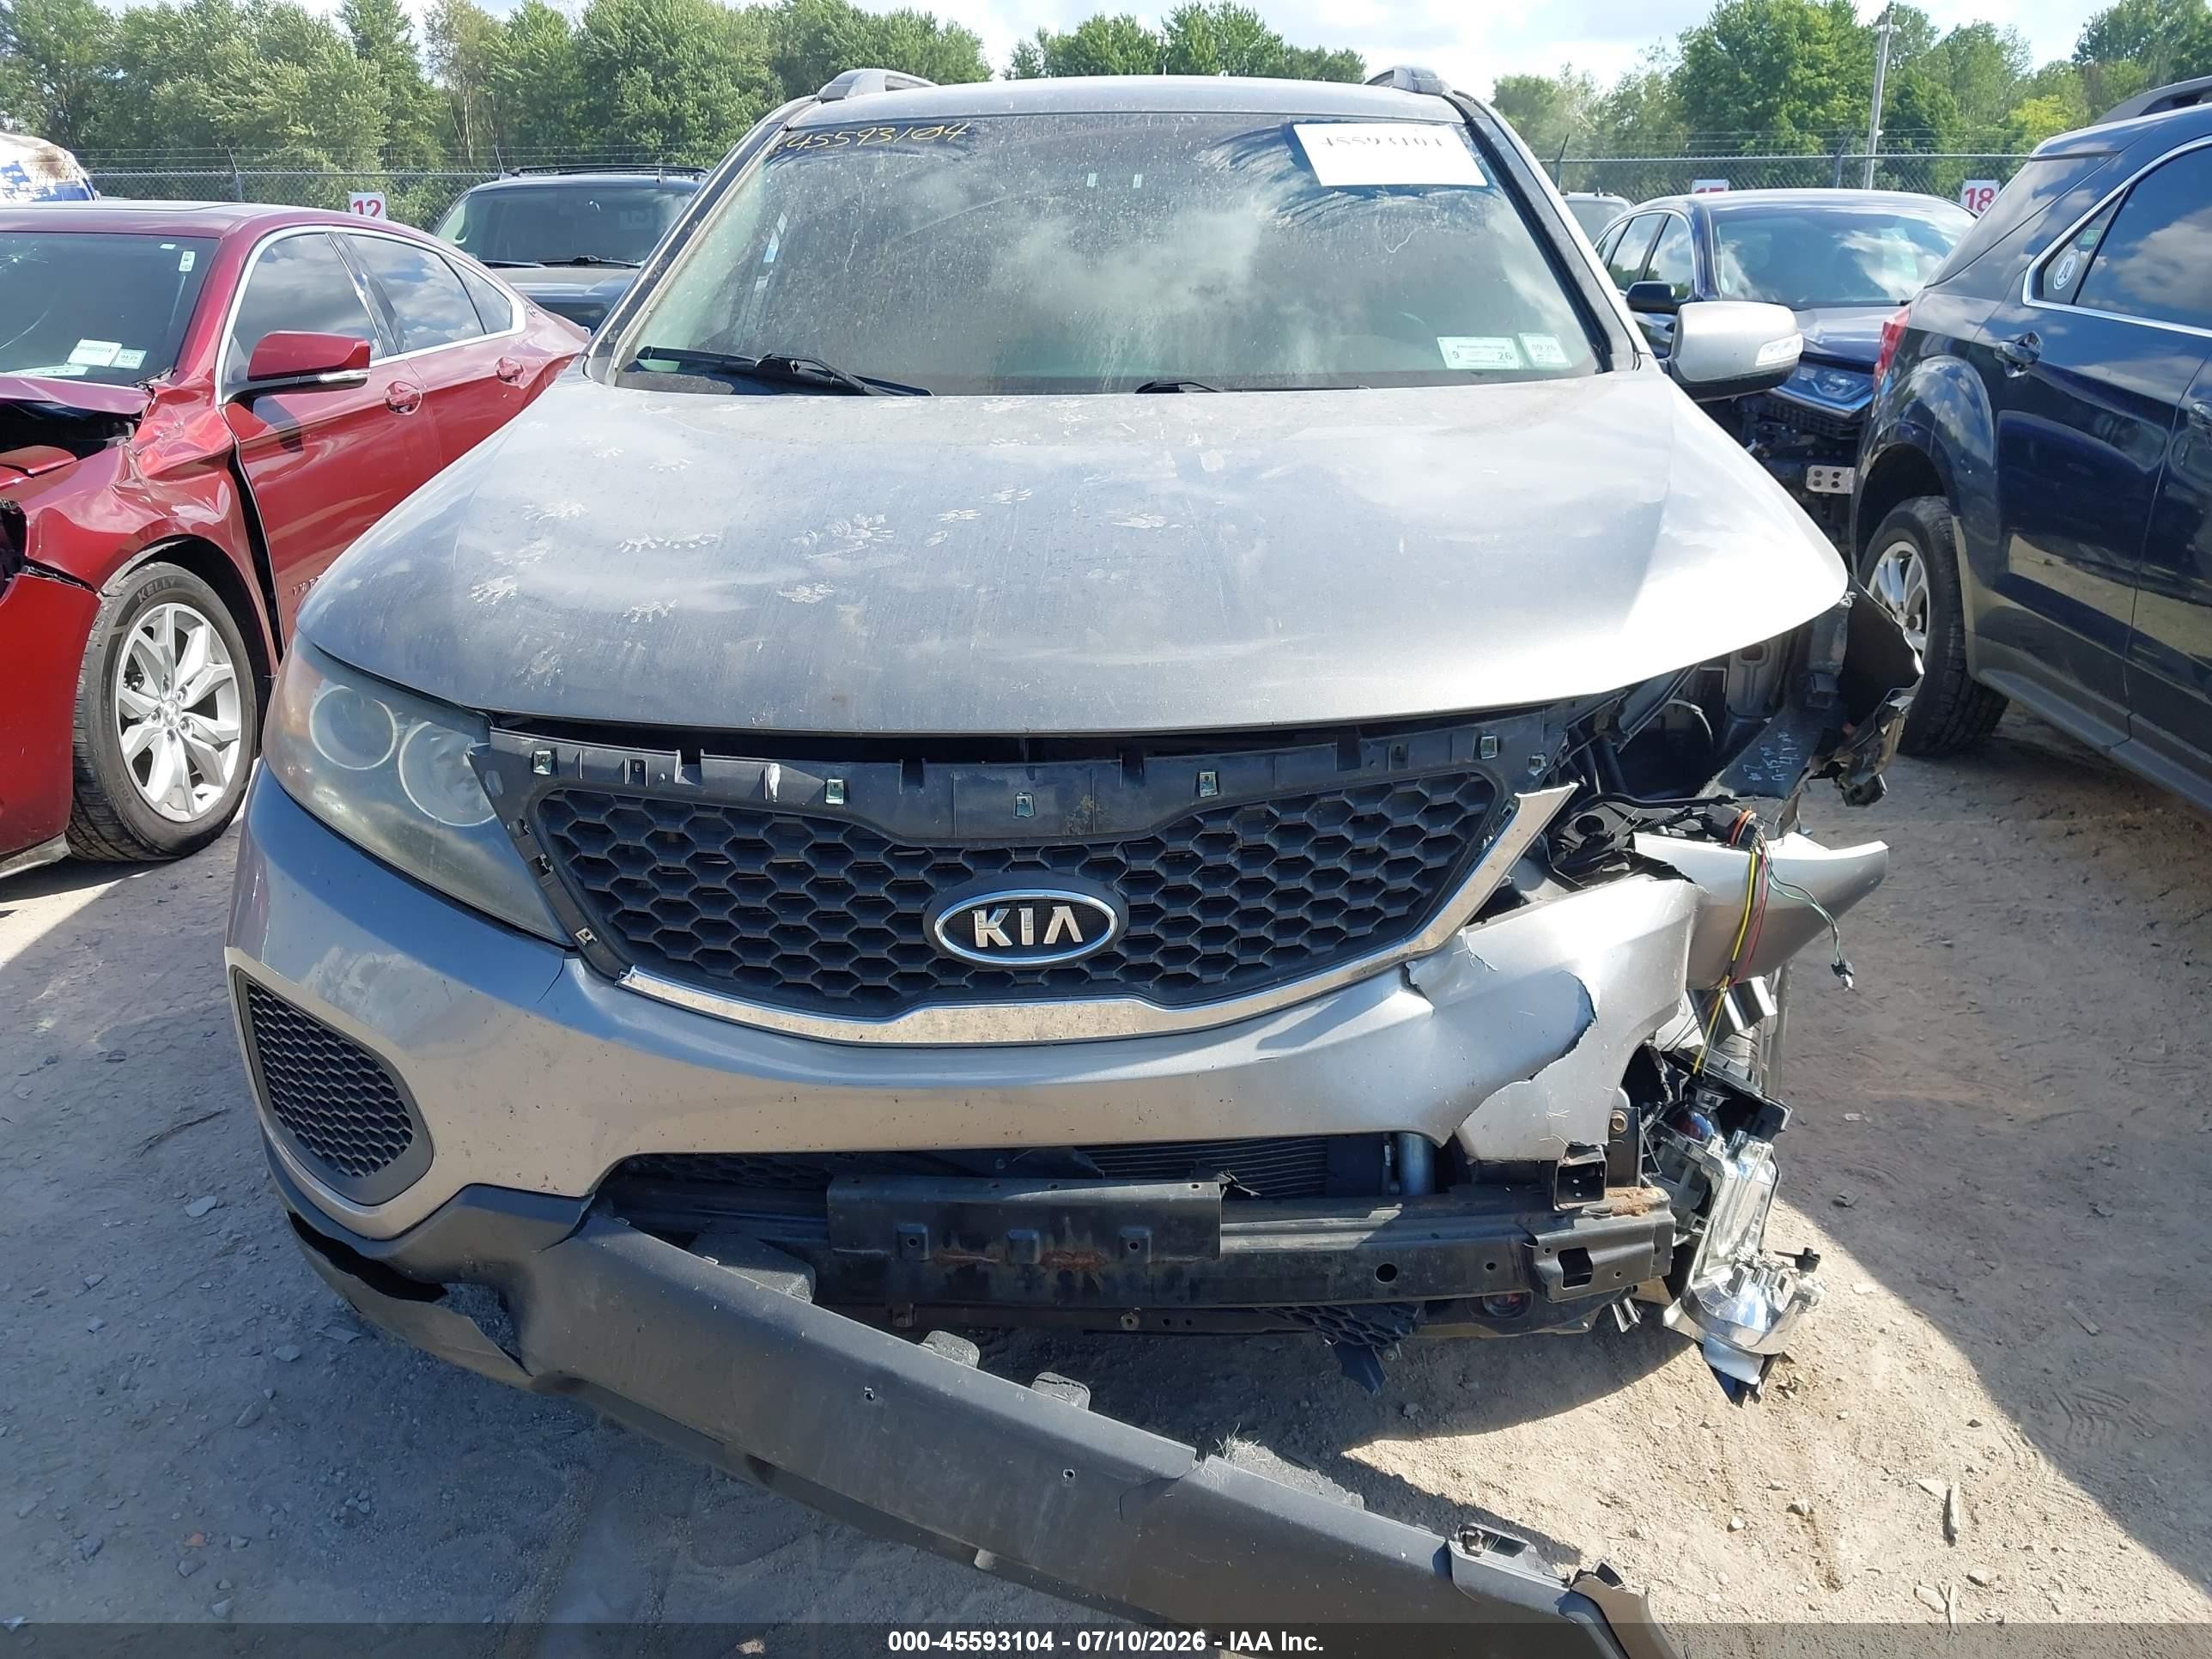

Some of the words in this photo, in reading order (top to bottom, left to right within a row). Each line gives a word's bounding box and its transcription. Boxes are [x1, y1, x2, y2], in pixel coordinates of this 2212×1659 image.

[787, 123, 970, 151] 45593104
[353, 199, 381, 217] 12
[1965, 187, 1995, 212] 18
[1497, 351, 1513, 361] 26
[137, 577, 176, 603] KELLY
[972, 906, 1084, 948] KIA
